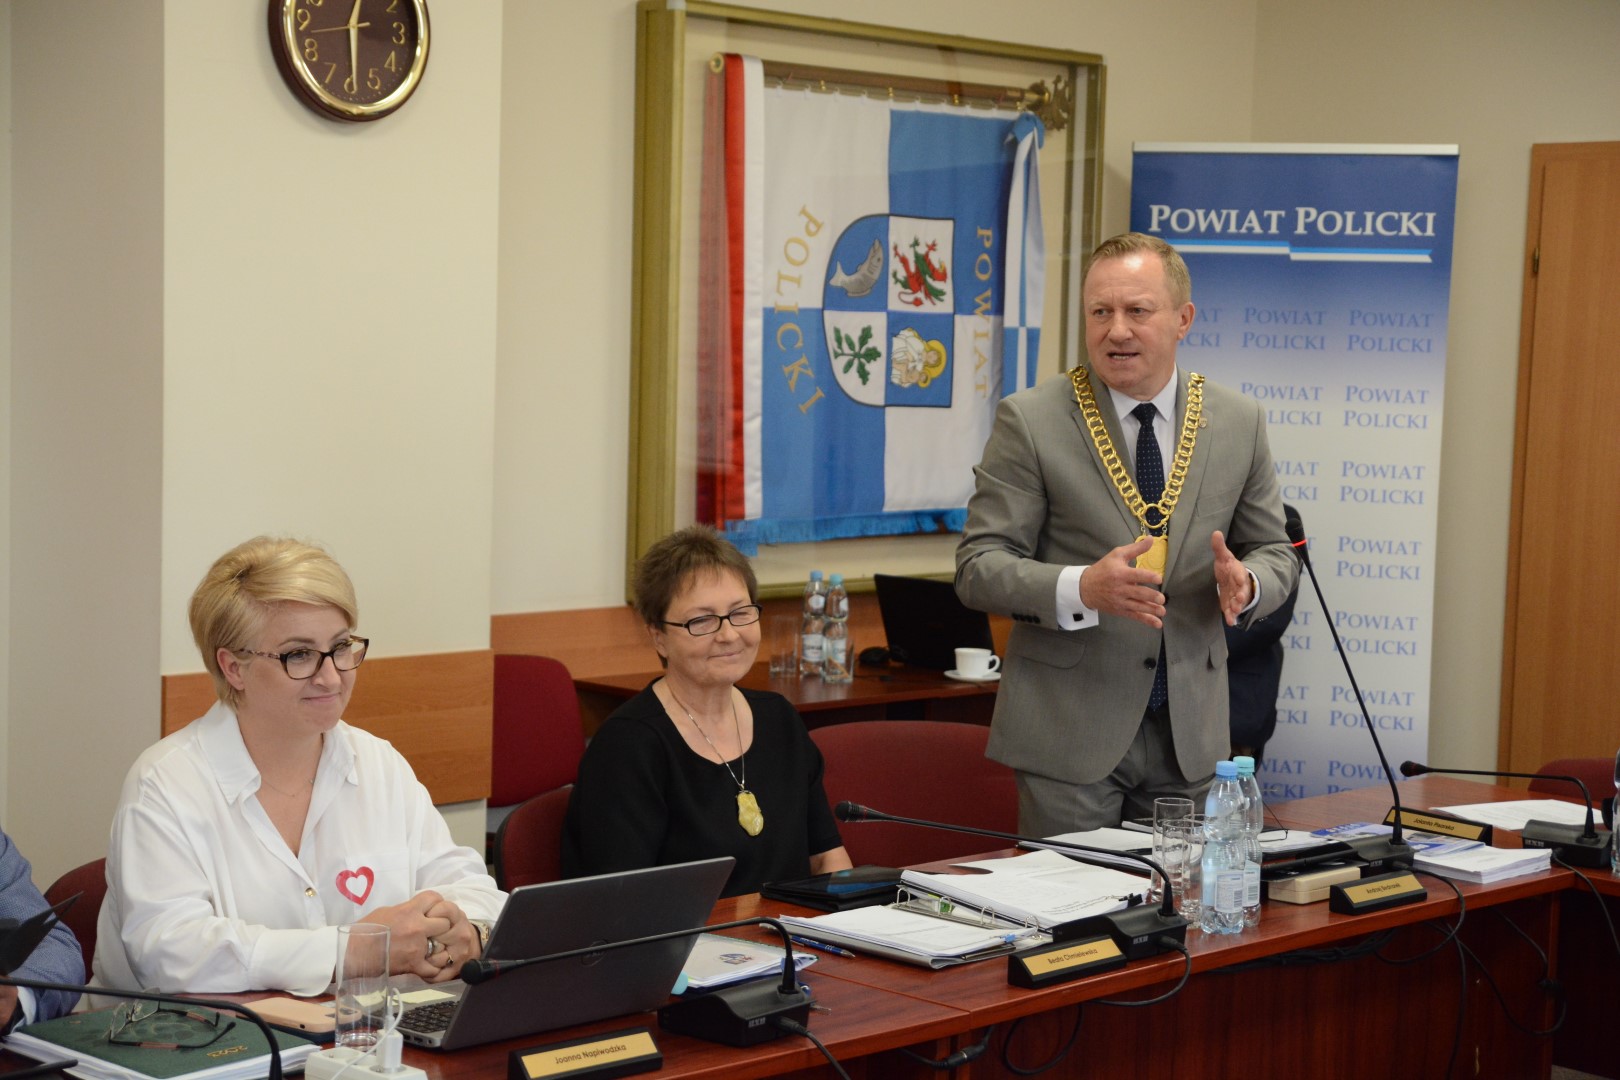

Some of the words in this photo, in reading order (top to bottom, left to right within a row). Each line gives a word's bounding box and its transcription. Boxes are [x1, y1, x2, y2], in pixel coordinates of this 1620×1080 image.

[296, 8, 311, 31] 9
[392, 22, 405, 44] 3
[304, 38, 318, 62] 8
[384, 50, 396, 72] 4
[324, 62, 337, 84] 7
[367, 68, 381, 90] 5
[1148, 204, 1285, 234] POWIAT
[1294, 207, 1437, 237] POLICKI
[773, 205, 826, 414] POLICKI
[973, 226, 993, 399] POWIAT
[1243, 307, 1327, 326] POWIAT
[1348, 309, 1433, 328] POWIAT
[1241, 331, 1326, 351] POLICKI
[1346, 334, 1433, 353] POLICKI
[1240, 382, 1323, 401] POWIAT
[1344, 385, 1429, 404] POWIAT
[1268, 409, 1322, 426] LICKI
[1343, 410, 1428, 430] POLICKI
[1341, 461, 1426, 480] POWIAT
[1339, 485, 1425, 505] POLICKI
[1337, 536, 1422, 556] POWIAT
[1336, 560, 1421, 581] POLICKI
[1334, 611, 1418, 631] POWIAT
[1332, 636, 1417, 656] POLICKI
[1331, 685, 1415, 706] POWIAT
[1329, 710, 1414, 731] POLICKI
[555, 1053, 582, 1065] Joanna
